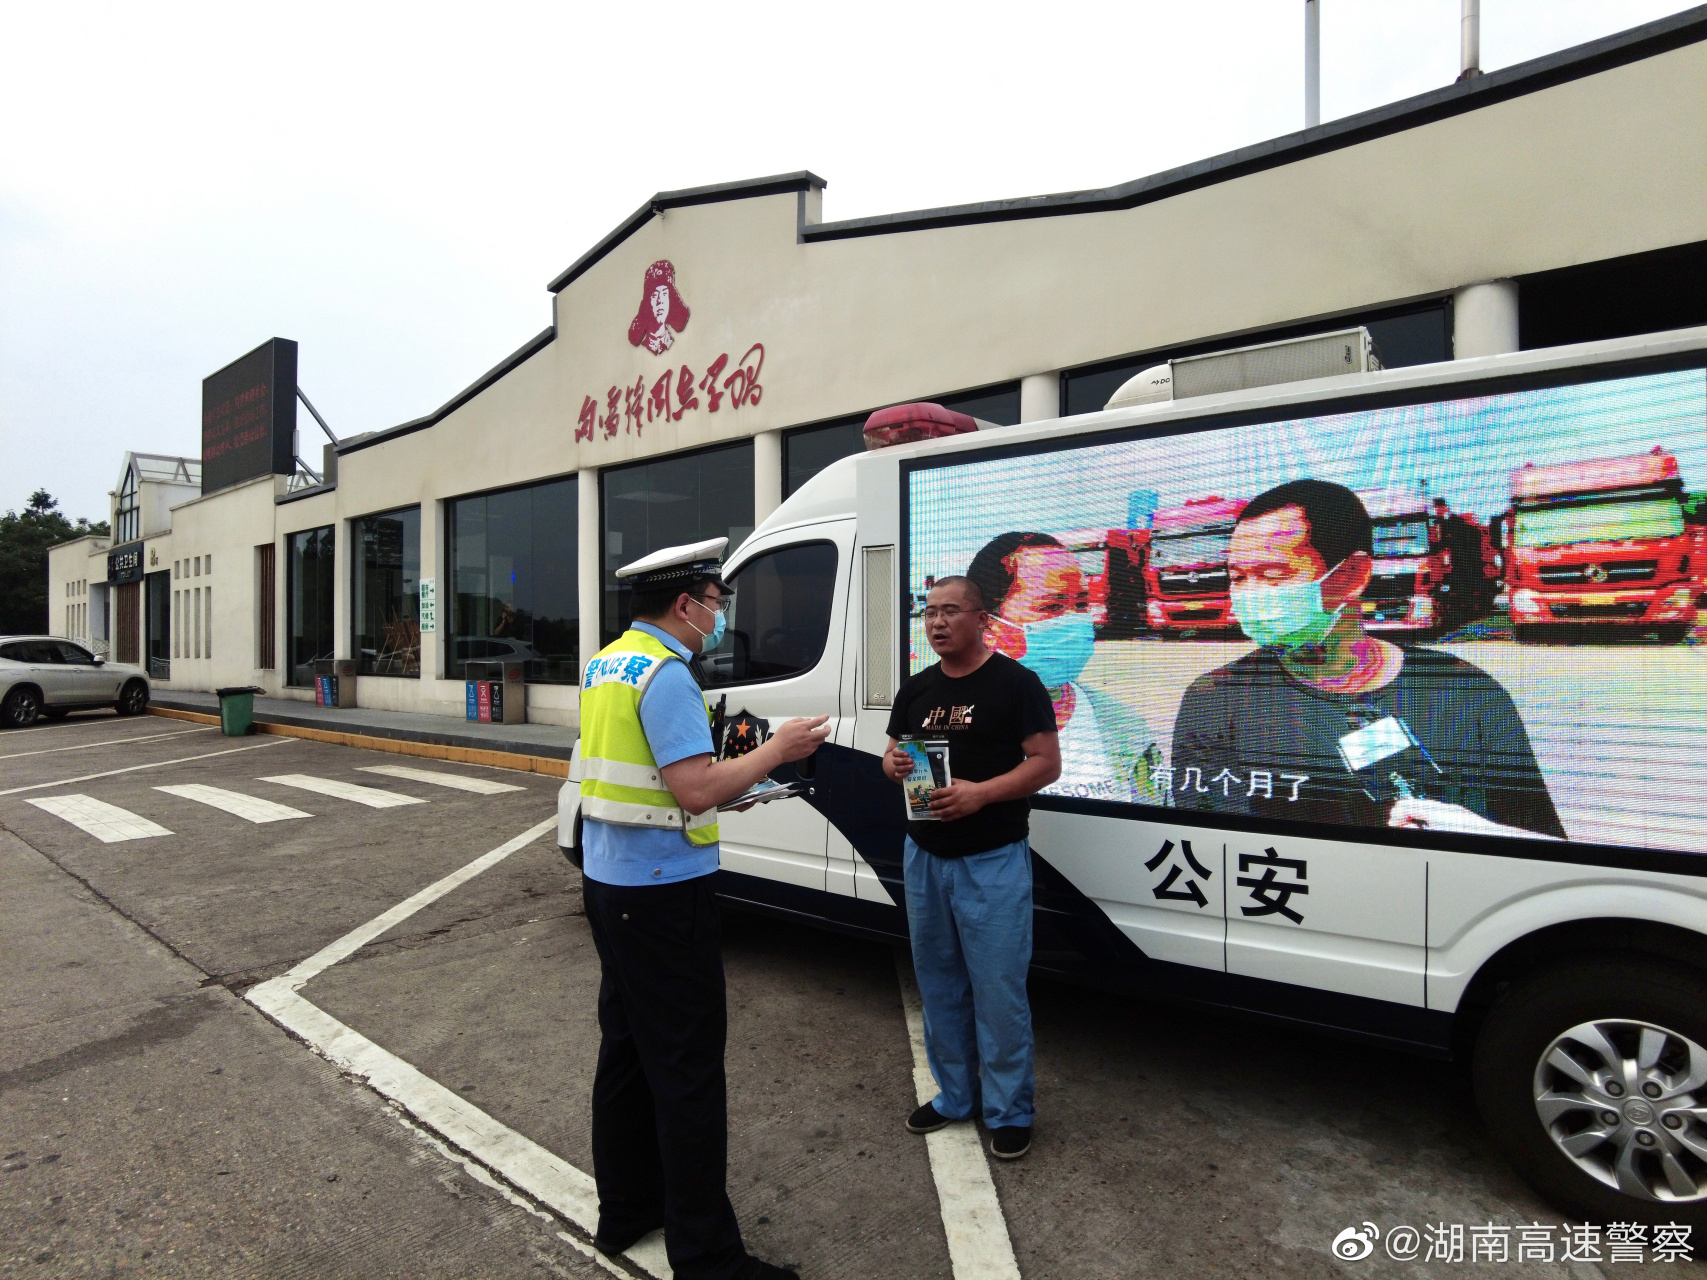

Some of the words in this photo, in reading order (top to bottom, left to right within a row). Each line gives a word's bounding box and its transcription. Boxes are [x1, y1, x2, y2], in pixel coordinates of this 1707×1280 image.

[115, 552, 138, 571] 公共卫生间
[621, 655, 653, 685] 察
[1150, 767, 1309, 801] 有几个月了
[1144, 839, 1309, 925] 公安
